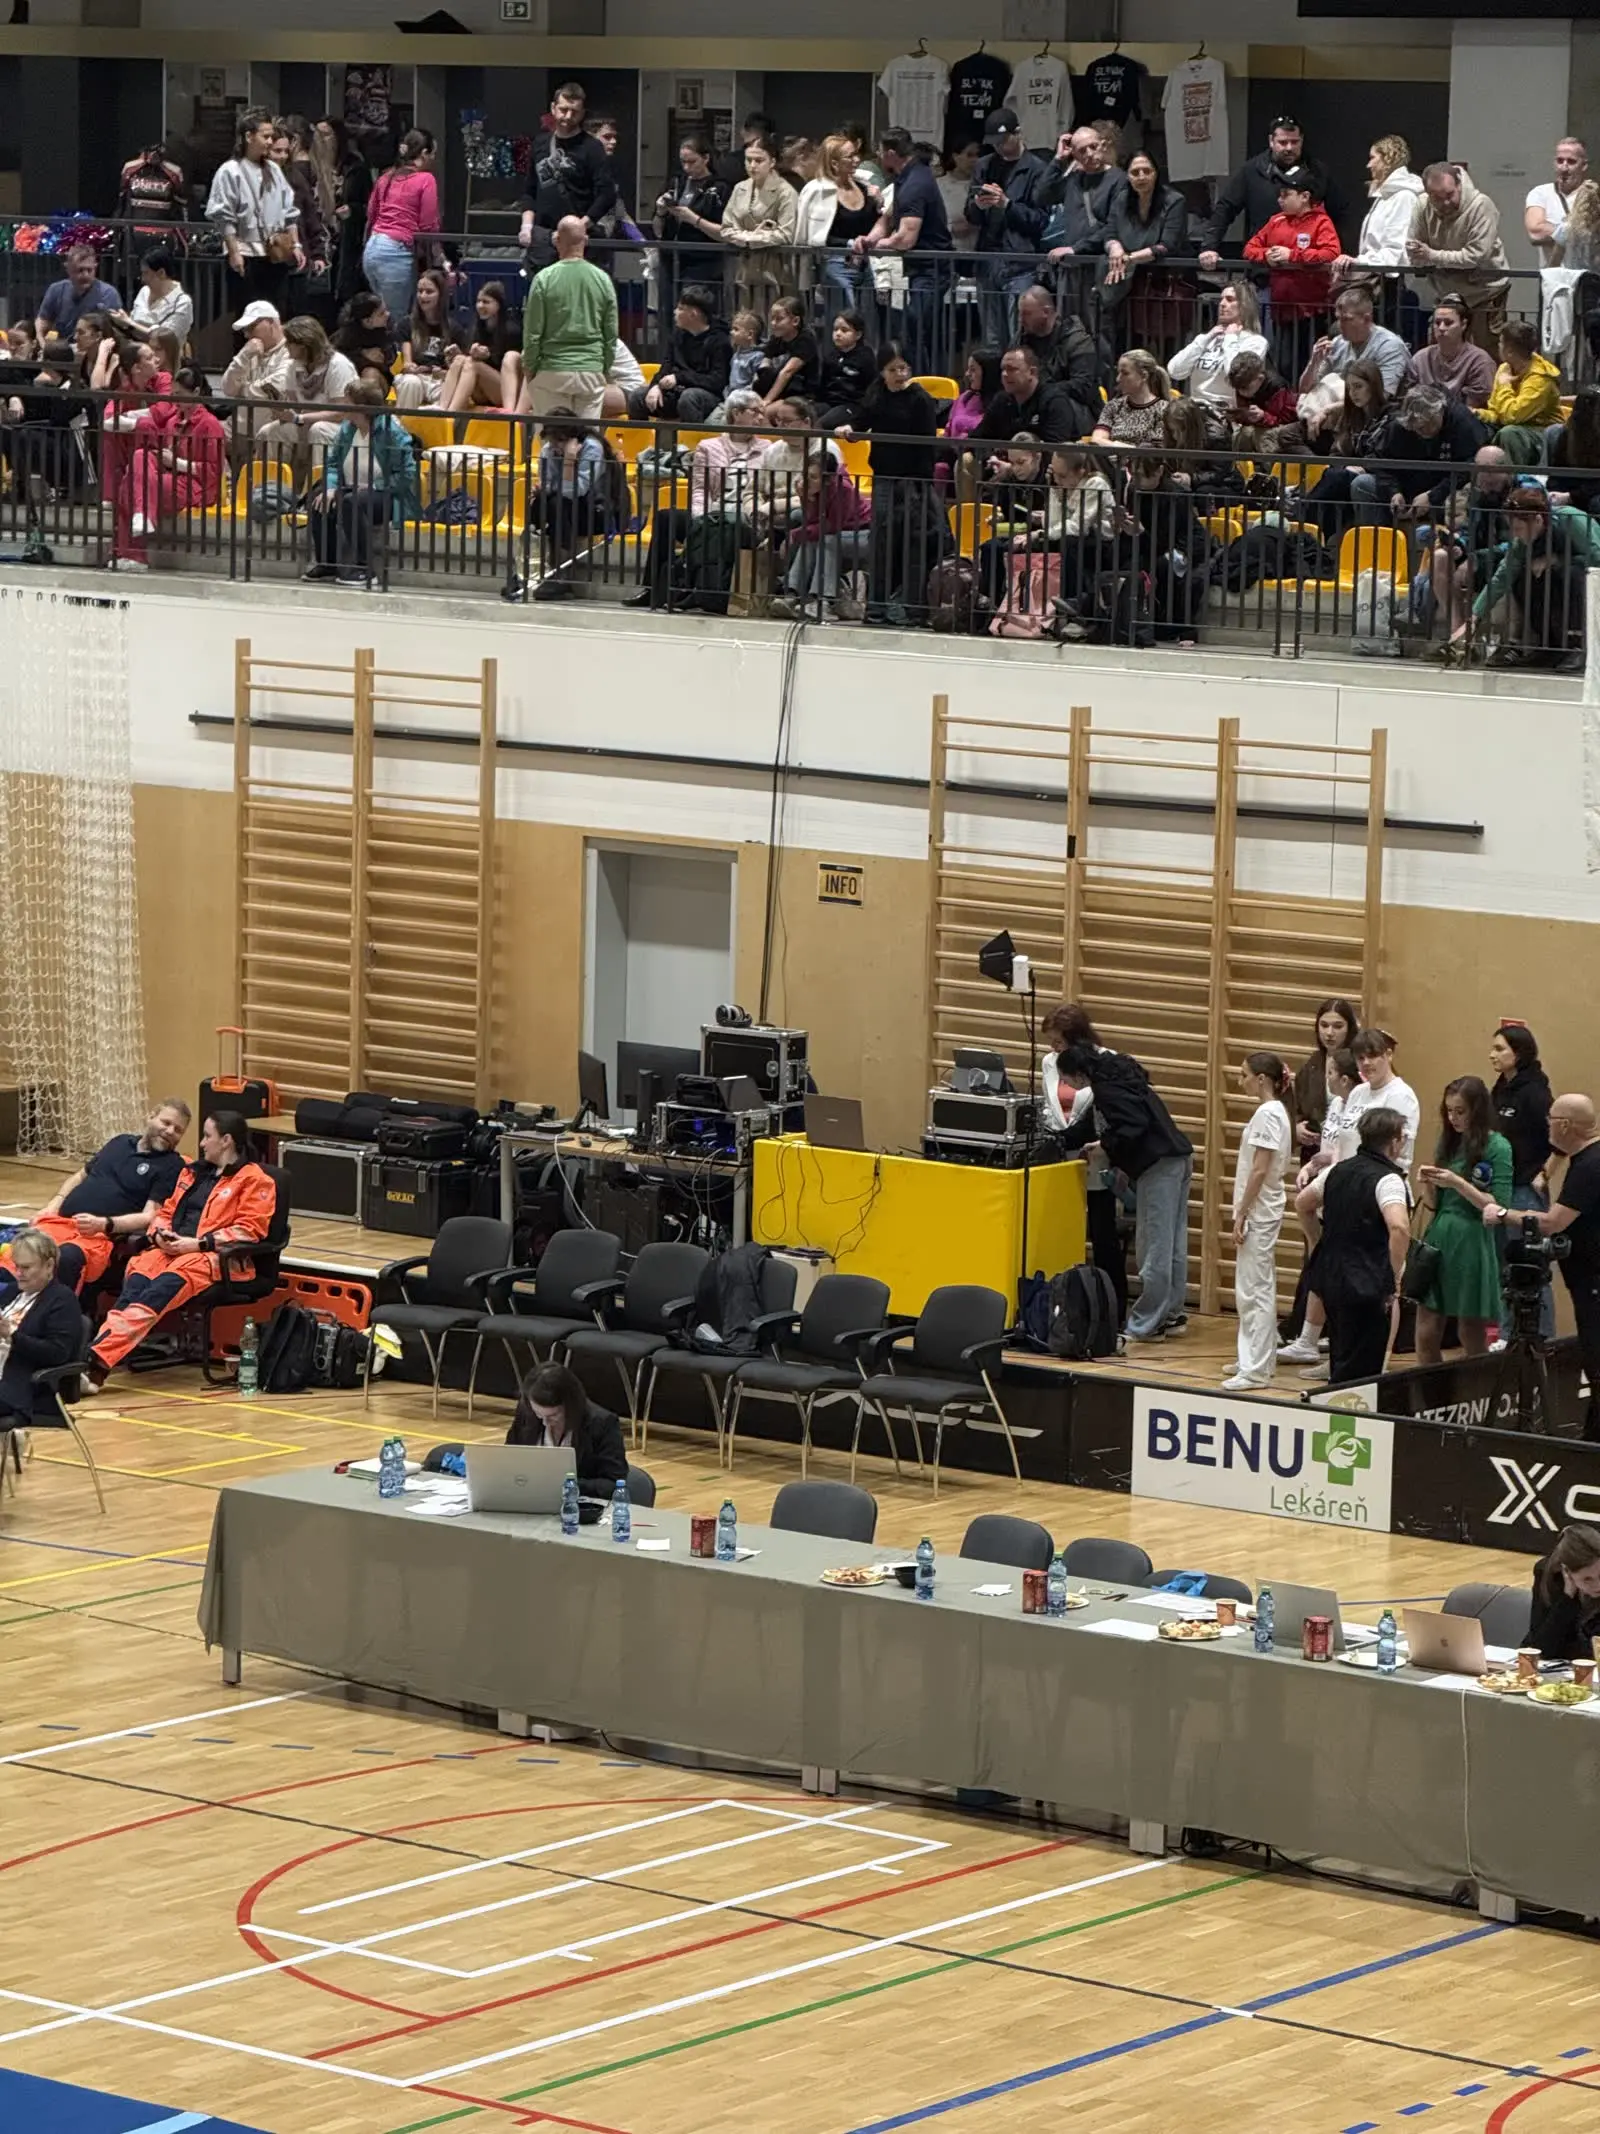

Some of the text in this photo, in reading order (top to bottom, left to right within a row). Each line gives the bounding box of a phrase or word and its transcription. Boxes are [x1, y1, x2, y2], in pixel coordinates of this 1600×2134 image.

[825, 873, 858, 896] INFO
[1147, 1408, 1305, 1479] BENU
[1270, 1485, 1369, 1523] Lekáreň
